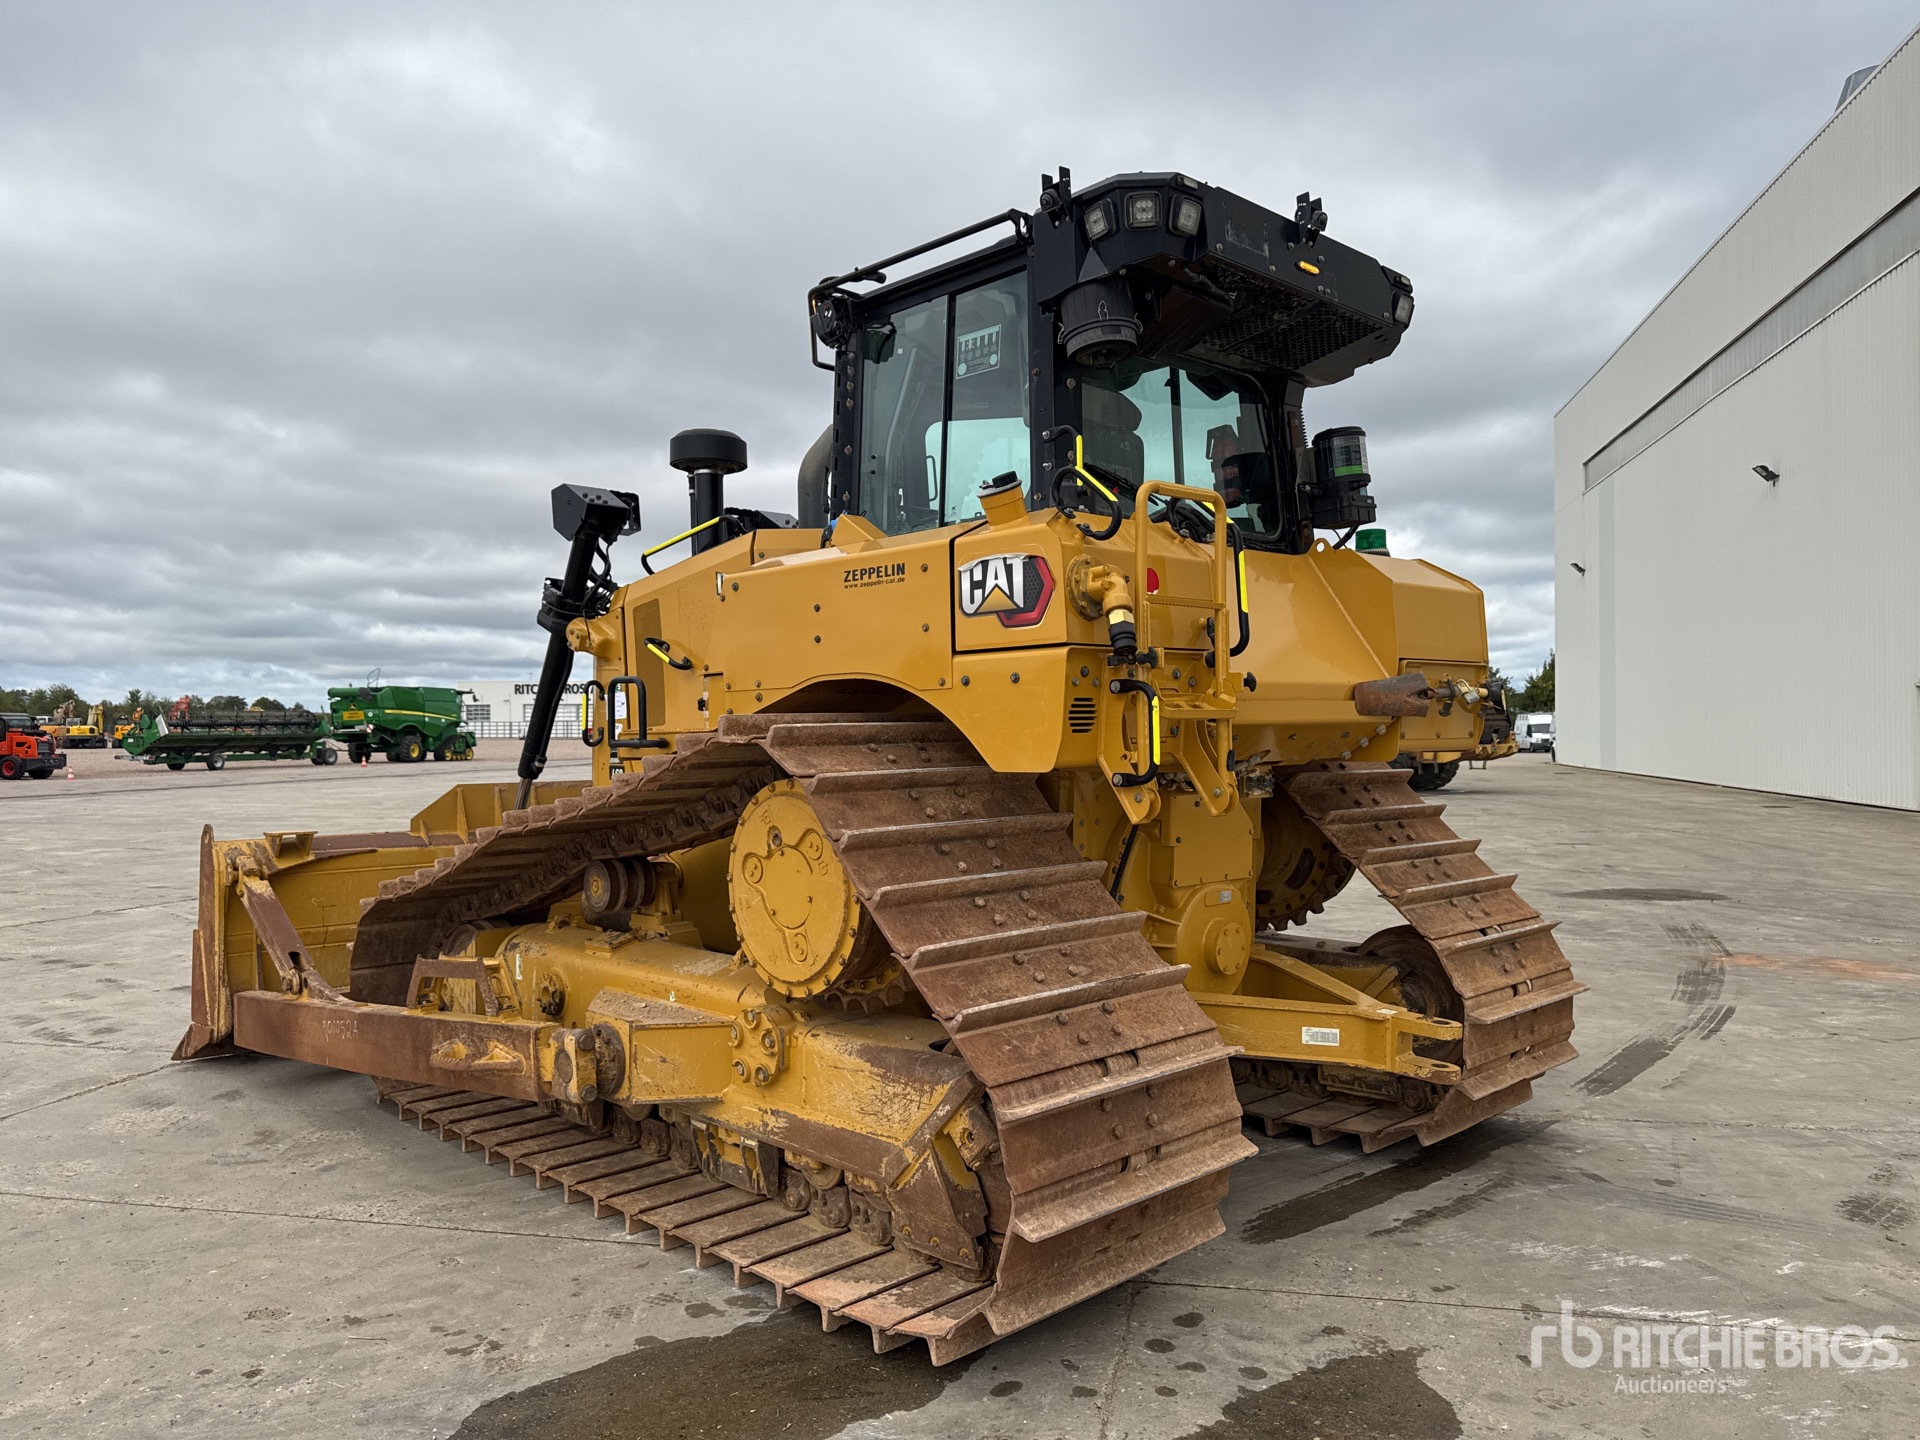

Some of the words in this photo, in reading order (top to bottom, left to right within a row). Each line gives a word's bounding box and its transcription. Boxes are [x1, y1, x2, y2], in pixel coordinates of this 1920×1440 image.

[843, 562, 906, 583] ZEPPELIN
[843, 577, 906, 589] www.zeppelin-cat.de
[960, 556, 1028, 614] CAT
[514, 684, 540, 695] RITC
